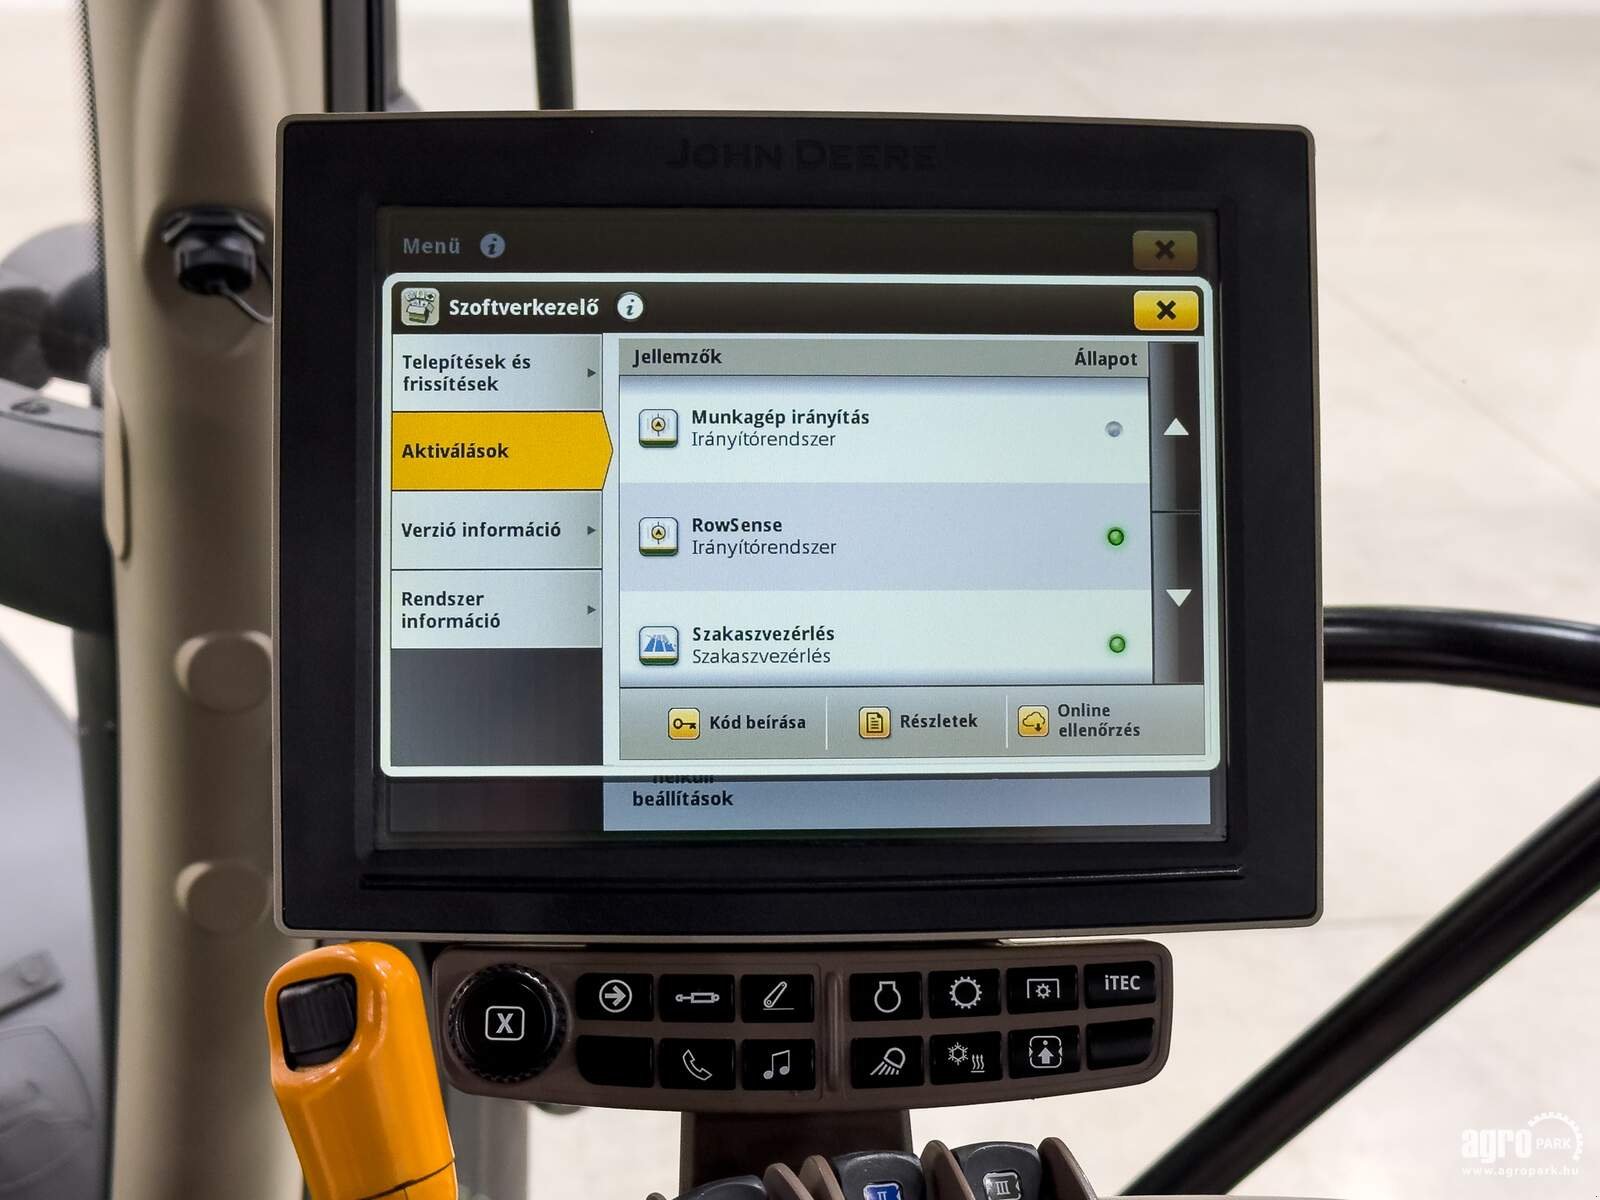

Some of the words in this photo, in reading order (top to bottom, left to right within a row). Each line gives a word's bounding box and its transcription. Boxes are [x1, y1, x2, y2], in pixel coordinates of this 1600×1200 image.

[664, 138, 783, 170] JOHN
[794, 138, 937, 171] DEERE
[403, 237, 460, 254] Menü
[449, 297, 600, 316] Szoftverkezelő
[402, 353, 506, 373] Telepítések
[511, 354, 531, 370] és
[632, 347, 722, 368] Jellemzők
[1074, 348, 1138, 370] Állapot
[402, 375, 500, 391] frissítések
[691, 409, 786, 429] Munkagép
[792, 408, 870, 429] irányítás
[691, 430, 836, 449] Irányítórendszer
[401, 442, 509, 459] Aktiválások
[401, 521, 456, 538] Verzió
[462, 521, 561, 538] információ
[692, 517, 783, 533] RowSense
[691, 538, 837, 557] Irányítórendszer
[401, 590, 485, 607] Rendszer
[401, 612, 501, 629] információ
[692, 625, 835, 642] Szakaszvezérlés
[692, 648, 831, 664] Szakaszvezérlés
[1057, 702, 1111, 718] Online
[709, 714, 741, 730] Kód
[746, 714, 806, 730] beírása
[900, 712, 978, 729] Részletek
[1058, 721, 1141, 738] ellenőrzés
[632, 790, 734, 806] beállítások
[1104, 974, 1141, 991] iTEC
